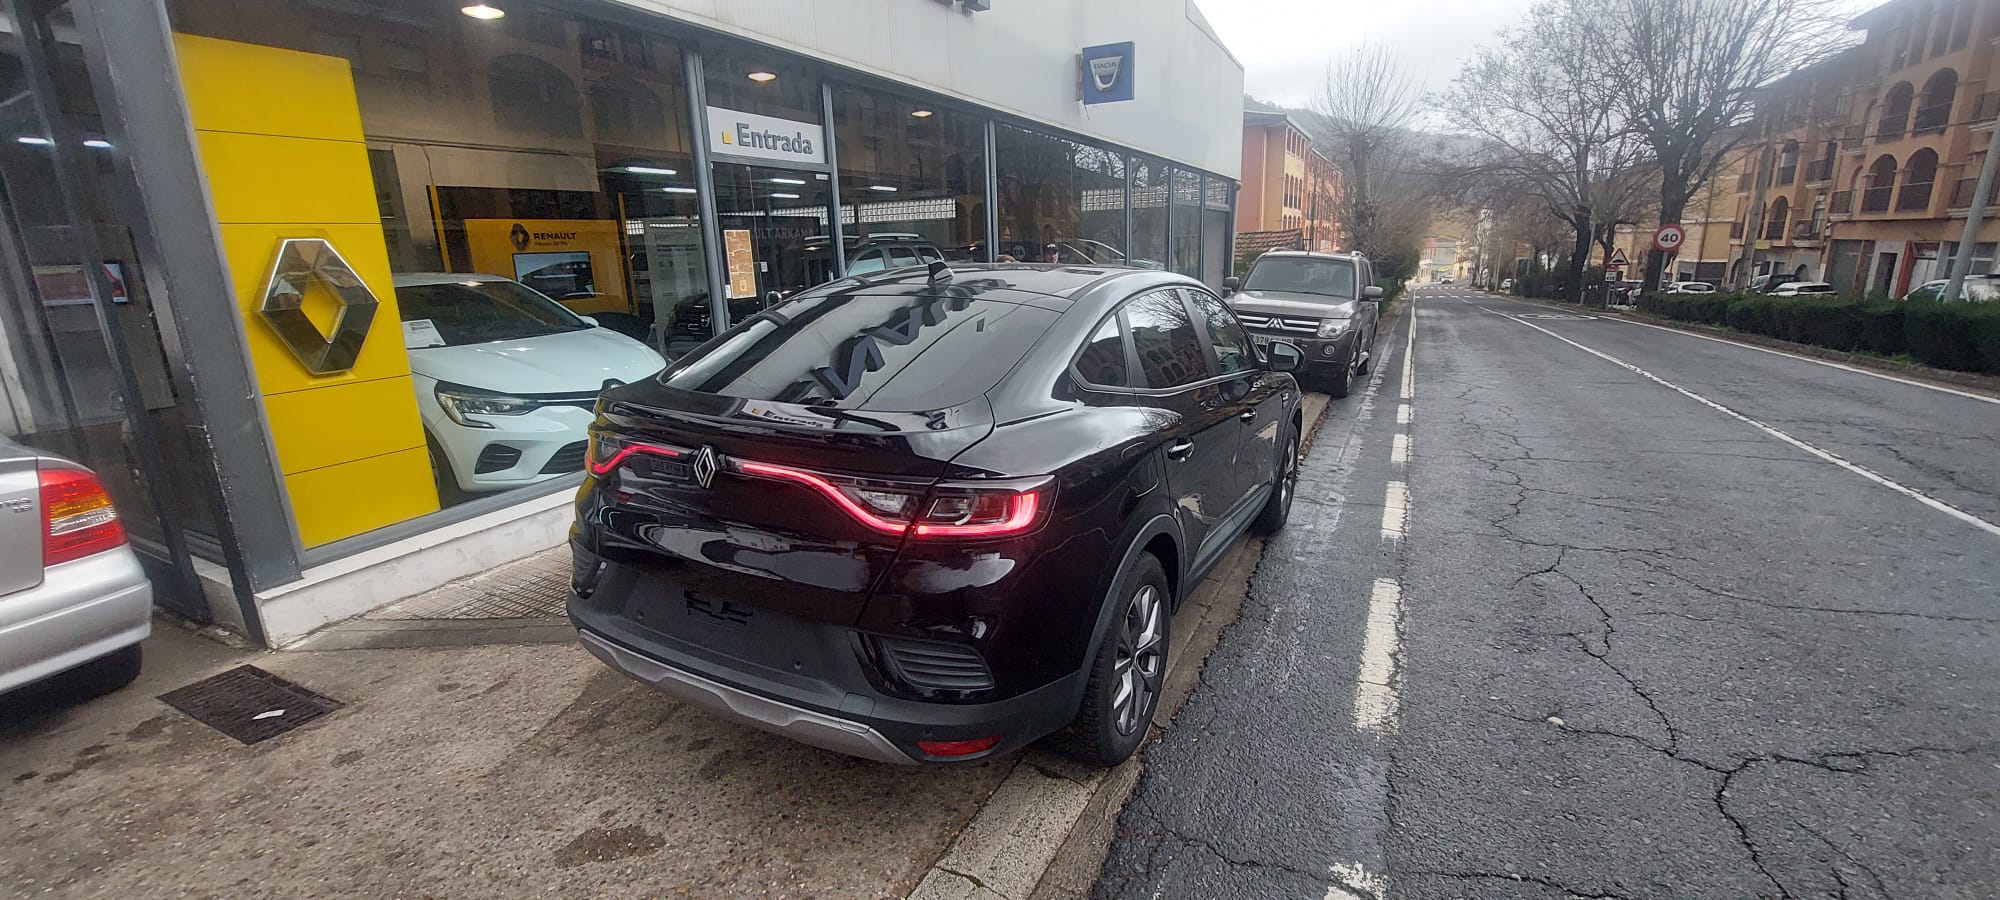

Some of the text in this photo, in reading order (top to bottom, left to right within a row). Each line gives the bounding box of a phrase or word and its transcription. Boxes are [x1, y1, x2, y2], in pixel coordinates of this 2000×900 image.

[736, 122, 814, 155] Entrada
[533, 232, 577, 241] RENAULT
[1660, 233, 1679, 243] 40
